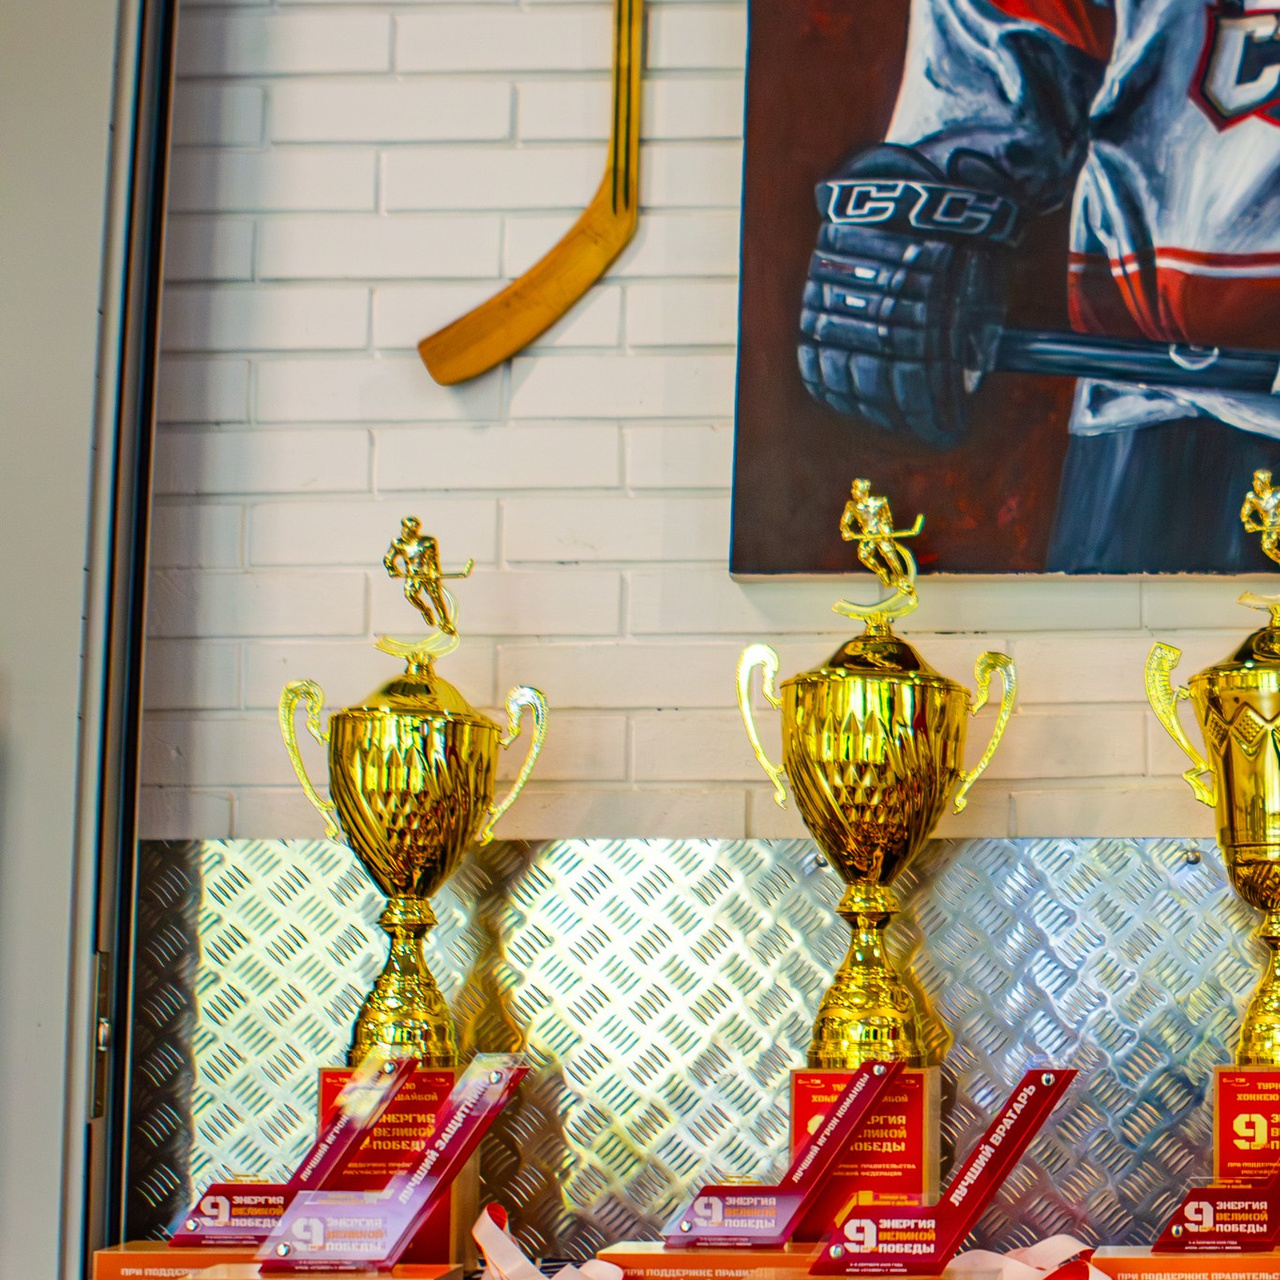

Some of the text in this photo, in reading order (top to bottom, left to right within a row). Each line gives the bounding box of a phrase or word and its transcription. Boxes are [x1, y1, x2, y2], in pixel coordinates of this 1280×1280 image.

[836, 1073, 870, 1124] КОМАНДЫ
[1236, 1093, 1279, 1102] ХОККЕЮ
[949, 1084, 1037, 1207] ЛУЧШИЙ ВРАТАРЬ
[1233, 1113, 1268, 1151] 9
[398, 1150, 440, 1205] ЛУЧШИЙ
[200, 1195, 285, 1227] 9 ЭНЕРГИЯ
[231, 1217, 283, 1229] ПОБЕДЫ
[693, 1195, 777, 1228] 9 ЭНЕРГИЯ
[724, 1218, 776, 1229] ПОБЕДЫ
[1184, 1201, 1268, 1233] 9 ЭНЕРГИЯ
[1216, 1210, 1268, 1221] ВЕЛИКОЙ
[843, 1218, 936, 1254] 9 ЭНЕРГИЯ
[1215, 1223, 1268, 1234] ПОБЕДЫ
[878, 1242, 935, 1255] ПОБЕДЫ
[1117, 1272, 1139, 1280] ПРИ
